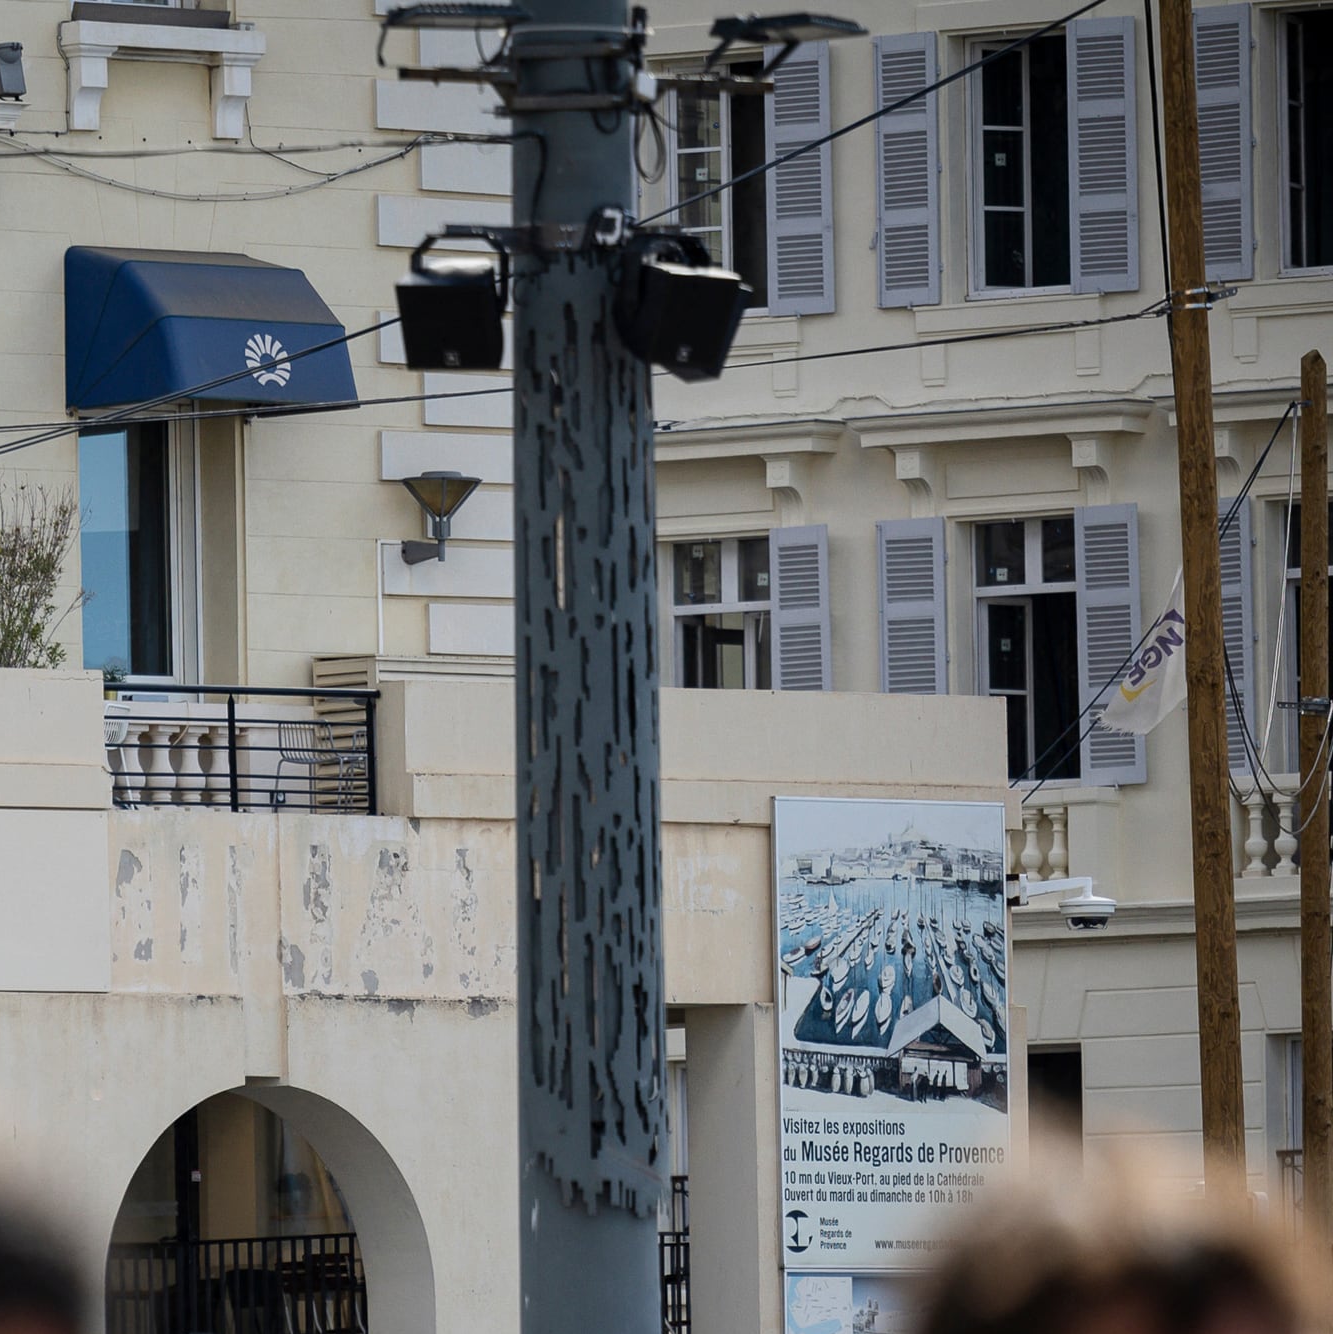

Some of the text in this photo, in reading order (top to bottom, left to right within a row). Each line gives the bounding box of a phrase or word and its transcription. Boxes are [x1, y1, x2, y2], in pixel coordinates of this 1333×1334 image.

[783, 1118, 905, 1138] Visitez les expositions
[784, 1141, 1005, 1167] du Musée Regards de Provence
[785, 1172, 797, 1184] 10
[799, 1174, 812, 1185] mn
[815, 1172, 826, 1185] du
[879, 1175, 890, 1185] au
[893, 1173, 912, 1188] pied
[914, 1173, 924, 1186] de
[927, 1173, 935, 1186] la
[937, 1173, 984, 1186] Cathédrale
[784, 1188, 973, 1204] Ouvert du mardi au dimanche de 10h à 18h
[820, 1217, 839, 1226] Musée
[820, 1229, 852, 1239] Regards de
[820, 1240, 847, 1250] Provence
